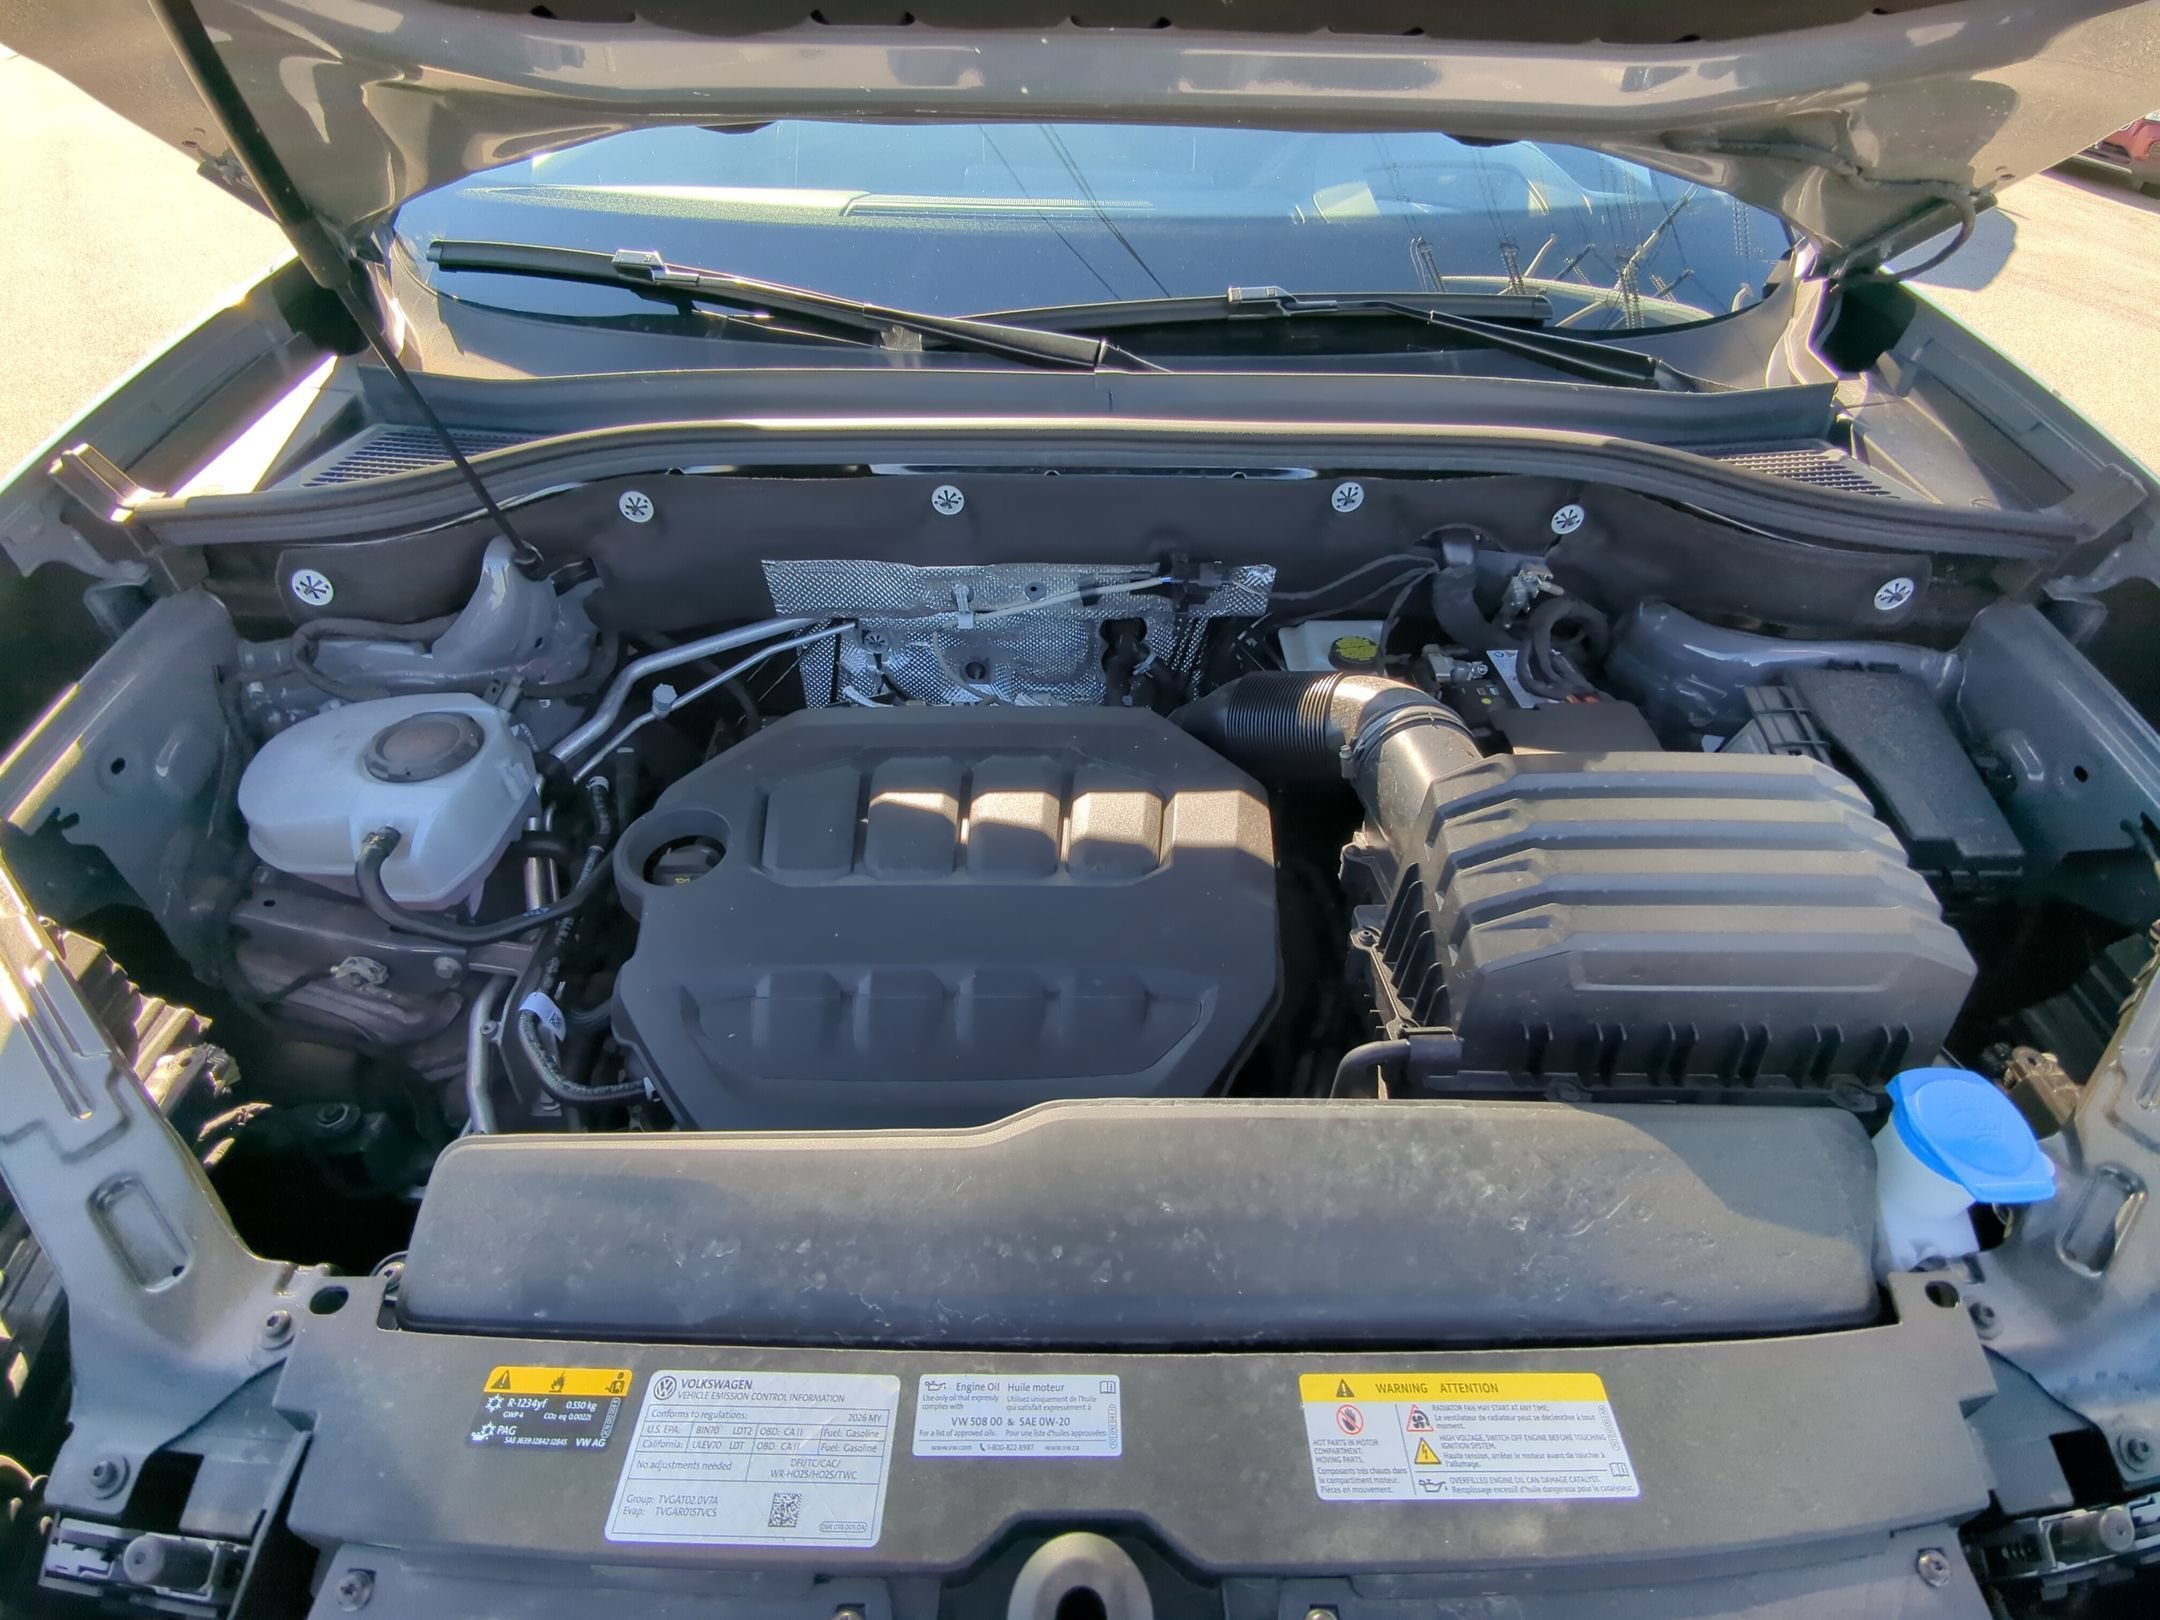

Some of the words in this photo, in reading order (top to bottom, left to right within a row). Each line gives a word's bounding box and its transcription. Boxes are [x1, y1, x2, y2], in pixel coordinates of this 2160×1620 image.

[681, 1378, 753, 1390] VOLKSWAGEN
[956, 1382, 986, 1393] Engine
[987, 1382, 1000, 1391] Oil
[1008, 1383, 1030, 1392] Huile
[1032, 1384, 1064, 1392] moteur
[1376, 1383, 1428, 1393] WARNING
[1440, 1383, 1499, 1393] ATTENTION
[677, 1391, 709, 1399] VEHICLE
[711, 1392, 749, 1400] EMISSION
[751, 1393, 787, 1401] CONTROL
[789, 1394, 845, 1402] INFORMATION
[971, 1395, 999, 1403] expressly
[1031, 1396, 1068, 1404] uniquement
[507, 1398, 548, 1411] R-1234yf
[566, 1401, 586, 1409] 0.550
[587, 1401, 597, 1412] kg
[651, 1409, 689, 1418] Conforms
[691, 1410, 699, 1418] to
[701, 1410, 748, 1420] regulations:
[848, 1414, 868, 1422] 2026
[869, 1414, 882, 1422] MY
[951, 1417, 968, 1426] VW
[970, 1417, 988, 1426] 508
[990, 1417, 1003, 1426] 00
[1007, 1418, 1015, 1426] &
[1019, 1417, 1037, 1426] SAE
[1039, 1417, 1071, 1426] 0W-20
[496, 1425, 517, 1436] PAG
[696, 1426, 720, 1434] BIN70
[732, 1427, 752, 1435] LDT2
[760, 1427, 780, 1436] OBD:
[823, 1429, 841, 1437] Fuel:
[846, 1429, 879, 1438] Gasoline
[935, 1429, 945, 1437] list
[946, 1429, 953, 1437] of
[954, 1429, 983, 1438] approved
[1046, 1429, 1070, 1437] d'huiles
[504, 1436, 517, 1444] SAE
[576, 1438, 592, 1447] VW
[591, 1438, 606, 1447] AG
[642, 1440, 684, 1448] California:
[692, 1440, 722, 1449] ULEV70
[729, 1441, 744, 1449] LDT
[756, 1442, 777, 1450] OBD:
[821, 1443, 840, 1451] Fuel:
[843, 1443, 877, 1452] Gasoline
[636, 1460, 648, 1468] No
[649, 1461, 700, 1471] adjustments
[701, 1462, 732, 1470] needed
[1317, 1467, 1355, 1475] Composants
[1327, 1477, 1372, 1485] compartiment
[1449, 1476, 1488, 1484] OVERFILLED
[627, 1494, 654, 1505] Group:
[623, 1506, 646, 1517] Evap:
